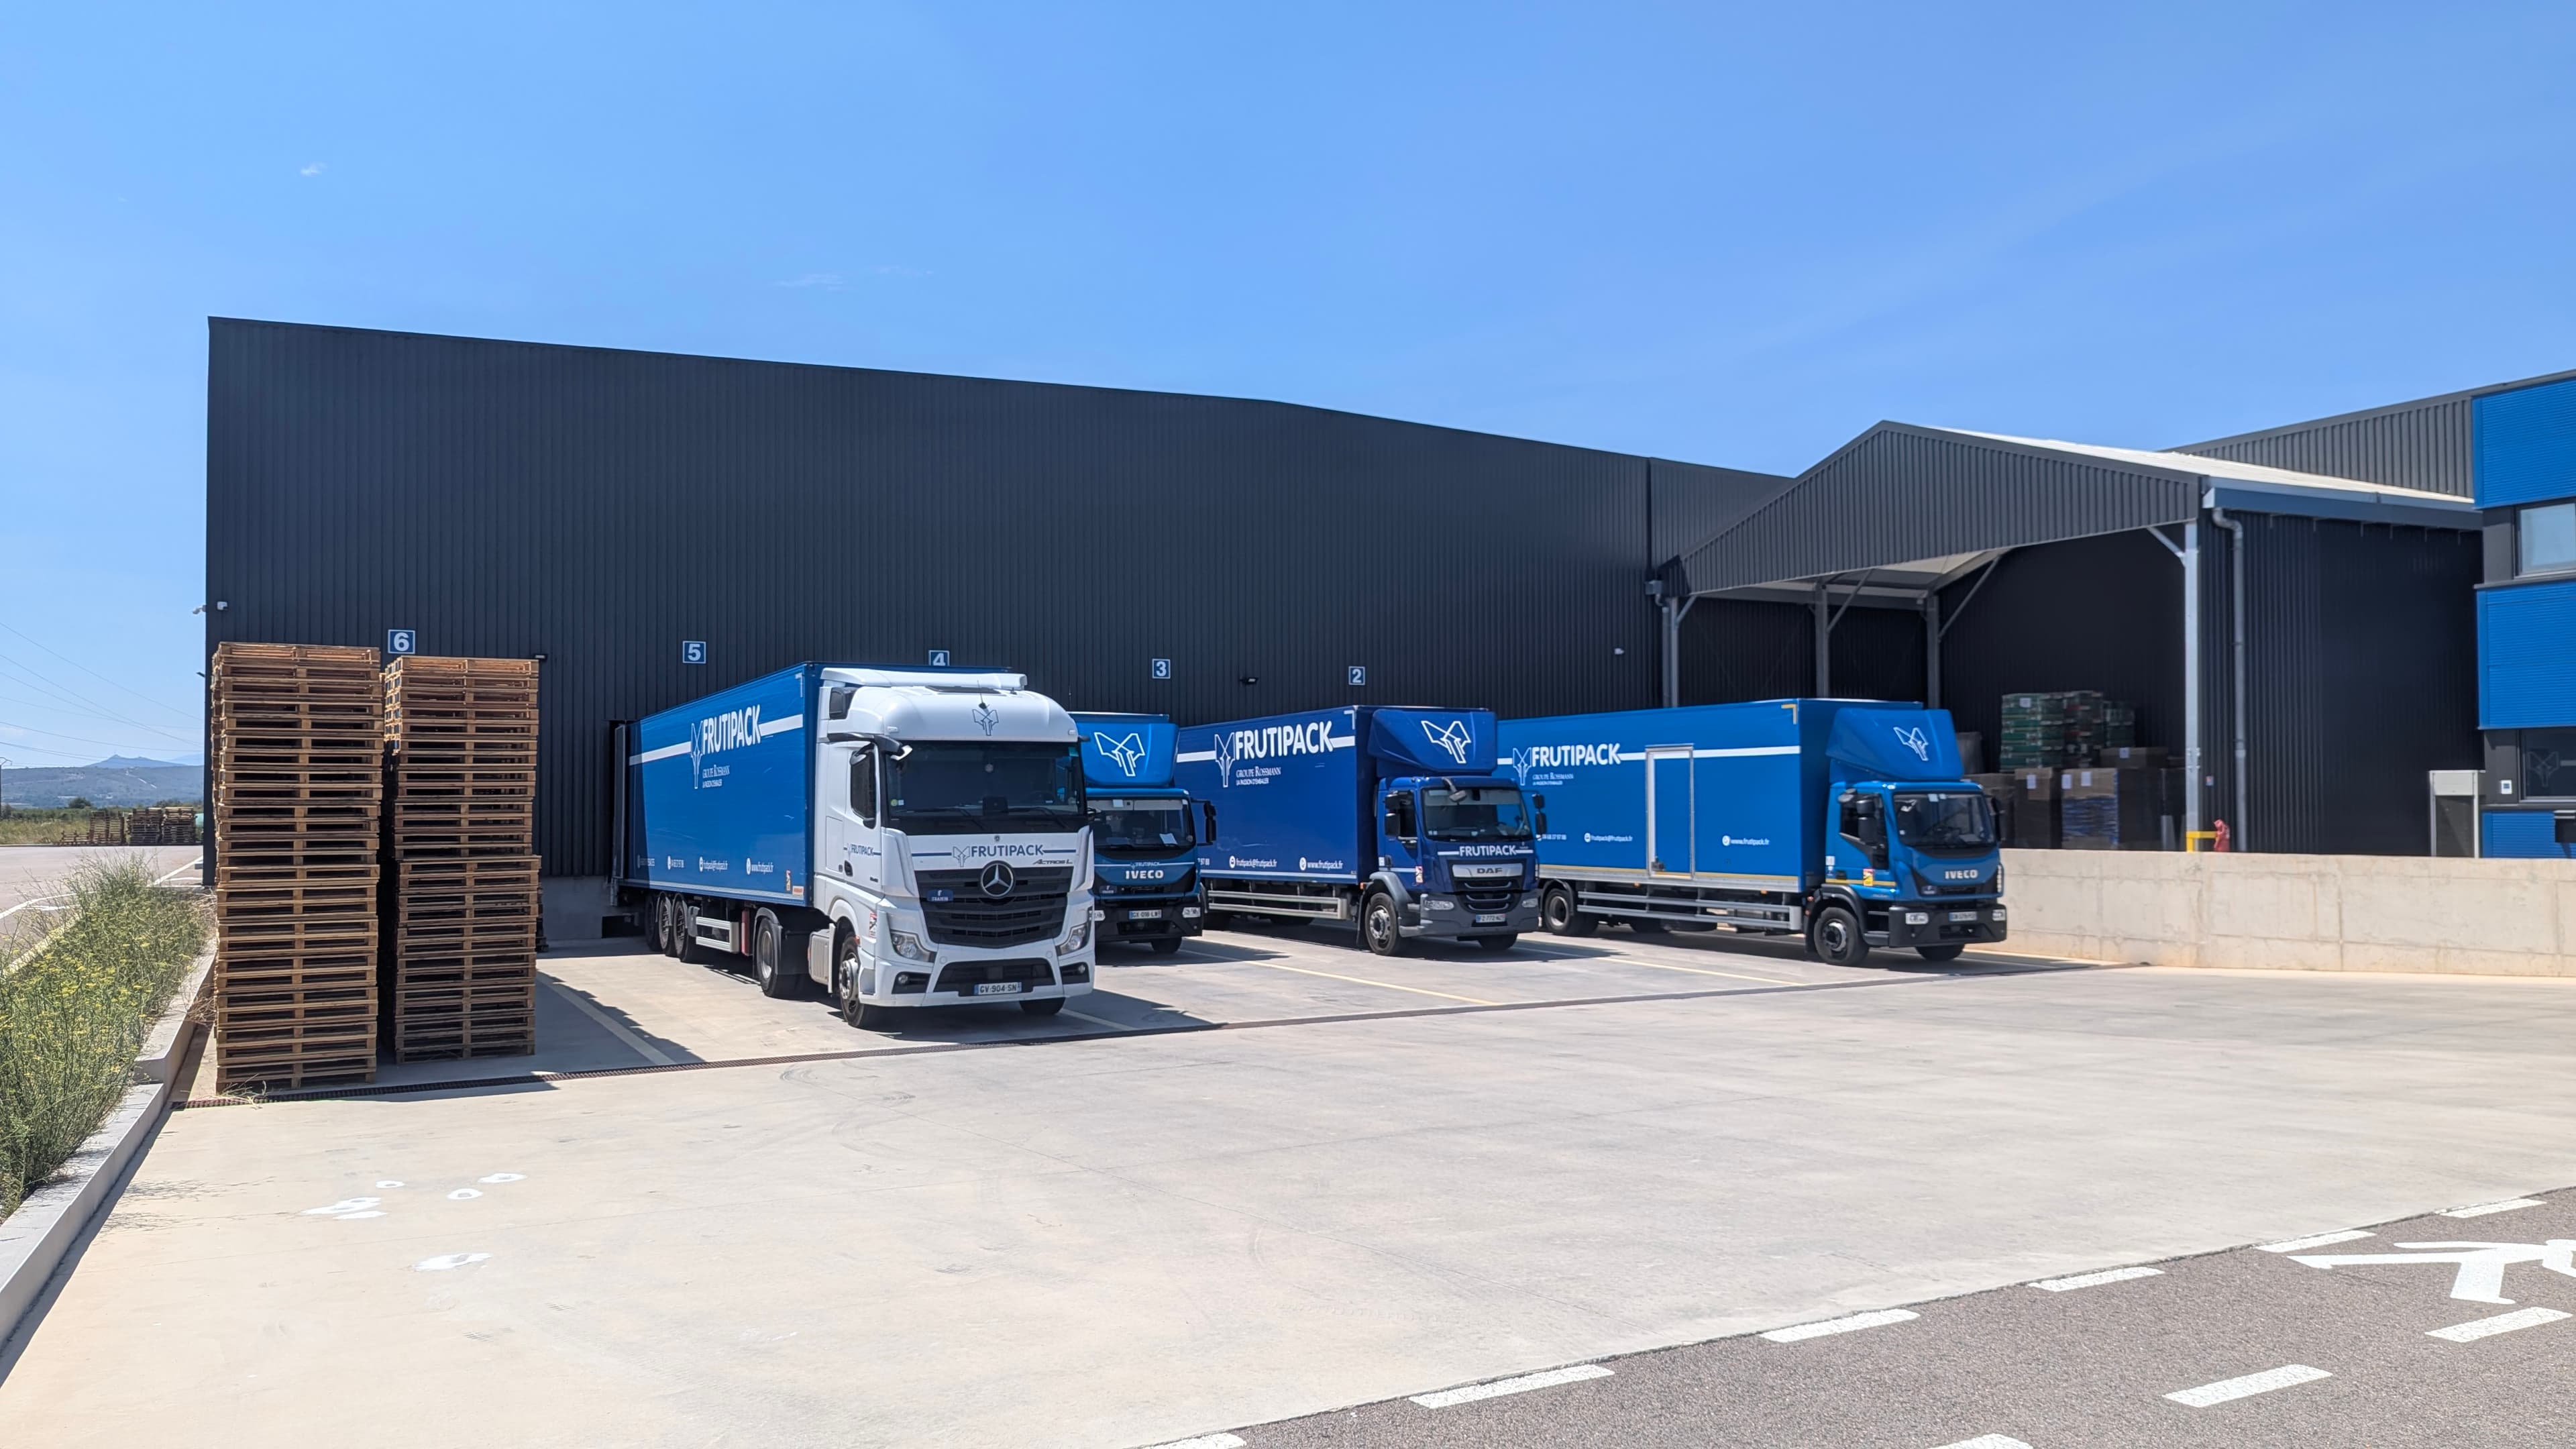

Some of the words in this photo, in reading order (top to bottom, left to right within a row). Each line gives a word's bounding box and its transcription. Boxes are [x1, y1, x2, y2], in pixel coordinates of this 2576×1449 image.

[393, 632, 410, 651] 6
[688, 643, 700, 661] 5
[933, 653, 946, 666] 4
[1156, 661, 1167, 677] 3
[1352, 668, 1362, 683] 2
[702, 704, 761, 755] FRUTIPACK
[1236, 720, 1334, 760] FRUTIPACK
[1532, 743, 1621, 767] FRUTIPACK
[850, 844, 874, 855] FRUTIPACK
[971, 845, 1044, 857] FRUTIPACK
[1460, 845, 1517, 856] FRUTIPACK
[1307, 860, 1343, 870] www.frutipack.fr
[1126, 870, 1164, 879] IVECO
[1945, 869, 1978, 879] IVECO
